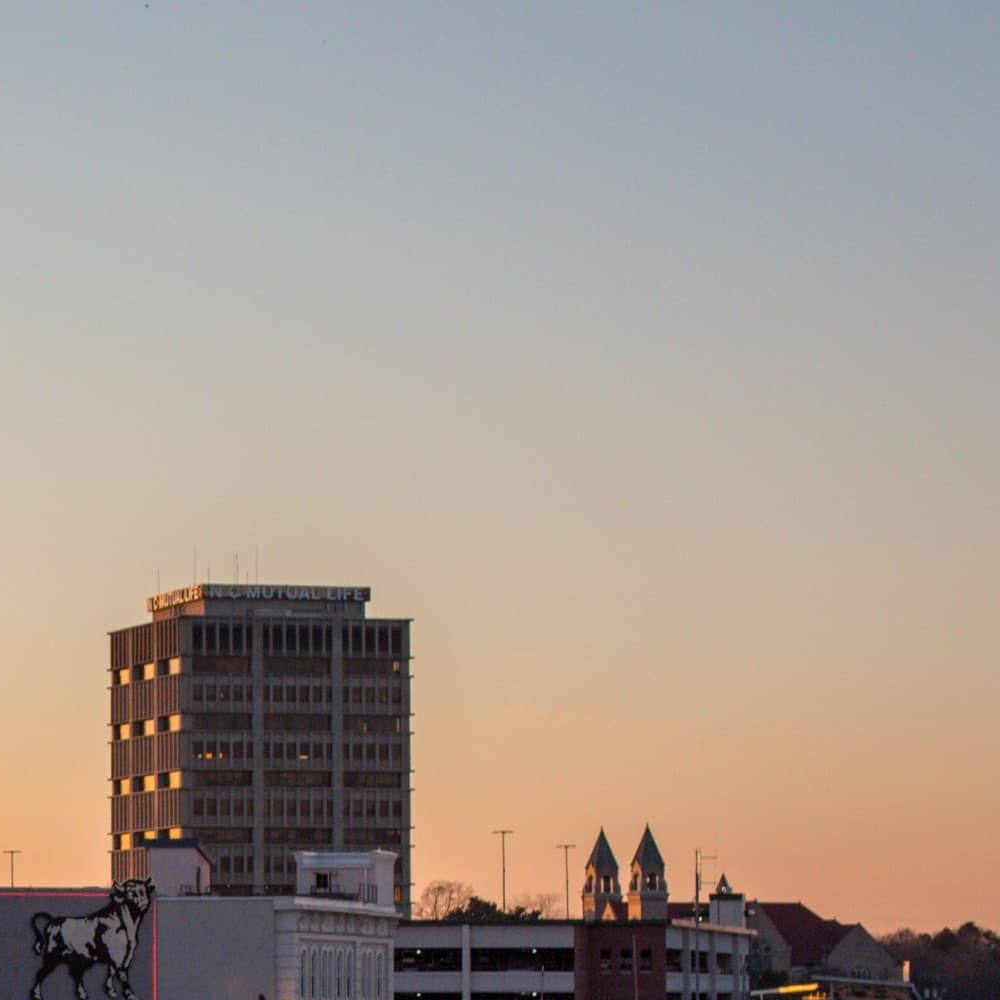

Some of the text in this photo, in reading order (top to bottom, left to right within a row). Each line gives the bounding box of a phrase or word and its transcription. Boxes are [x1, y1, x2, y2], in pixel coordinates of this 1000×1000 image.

[159, 589, 185, 609] MUTUAL
[184, 585, 202, 602] LIFE
[246, 585, 321, 600] MUTUAL
[326, 587, 364, 601] LIFE
